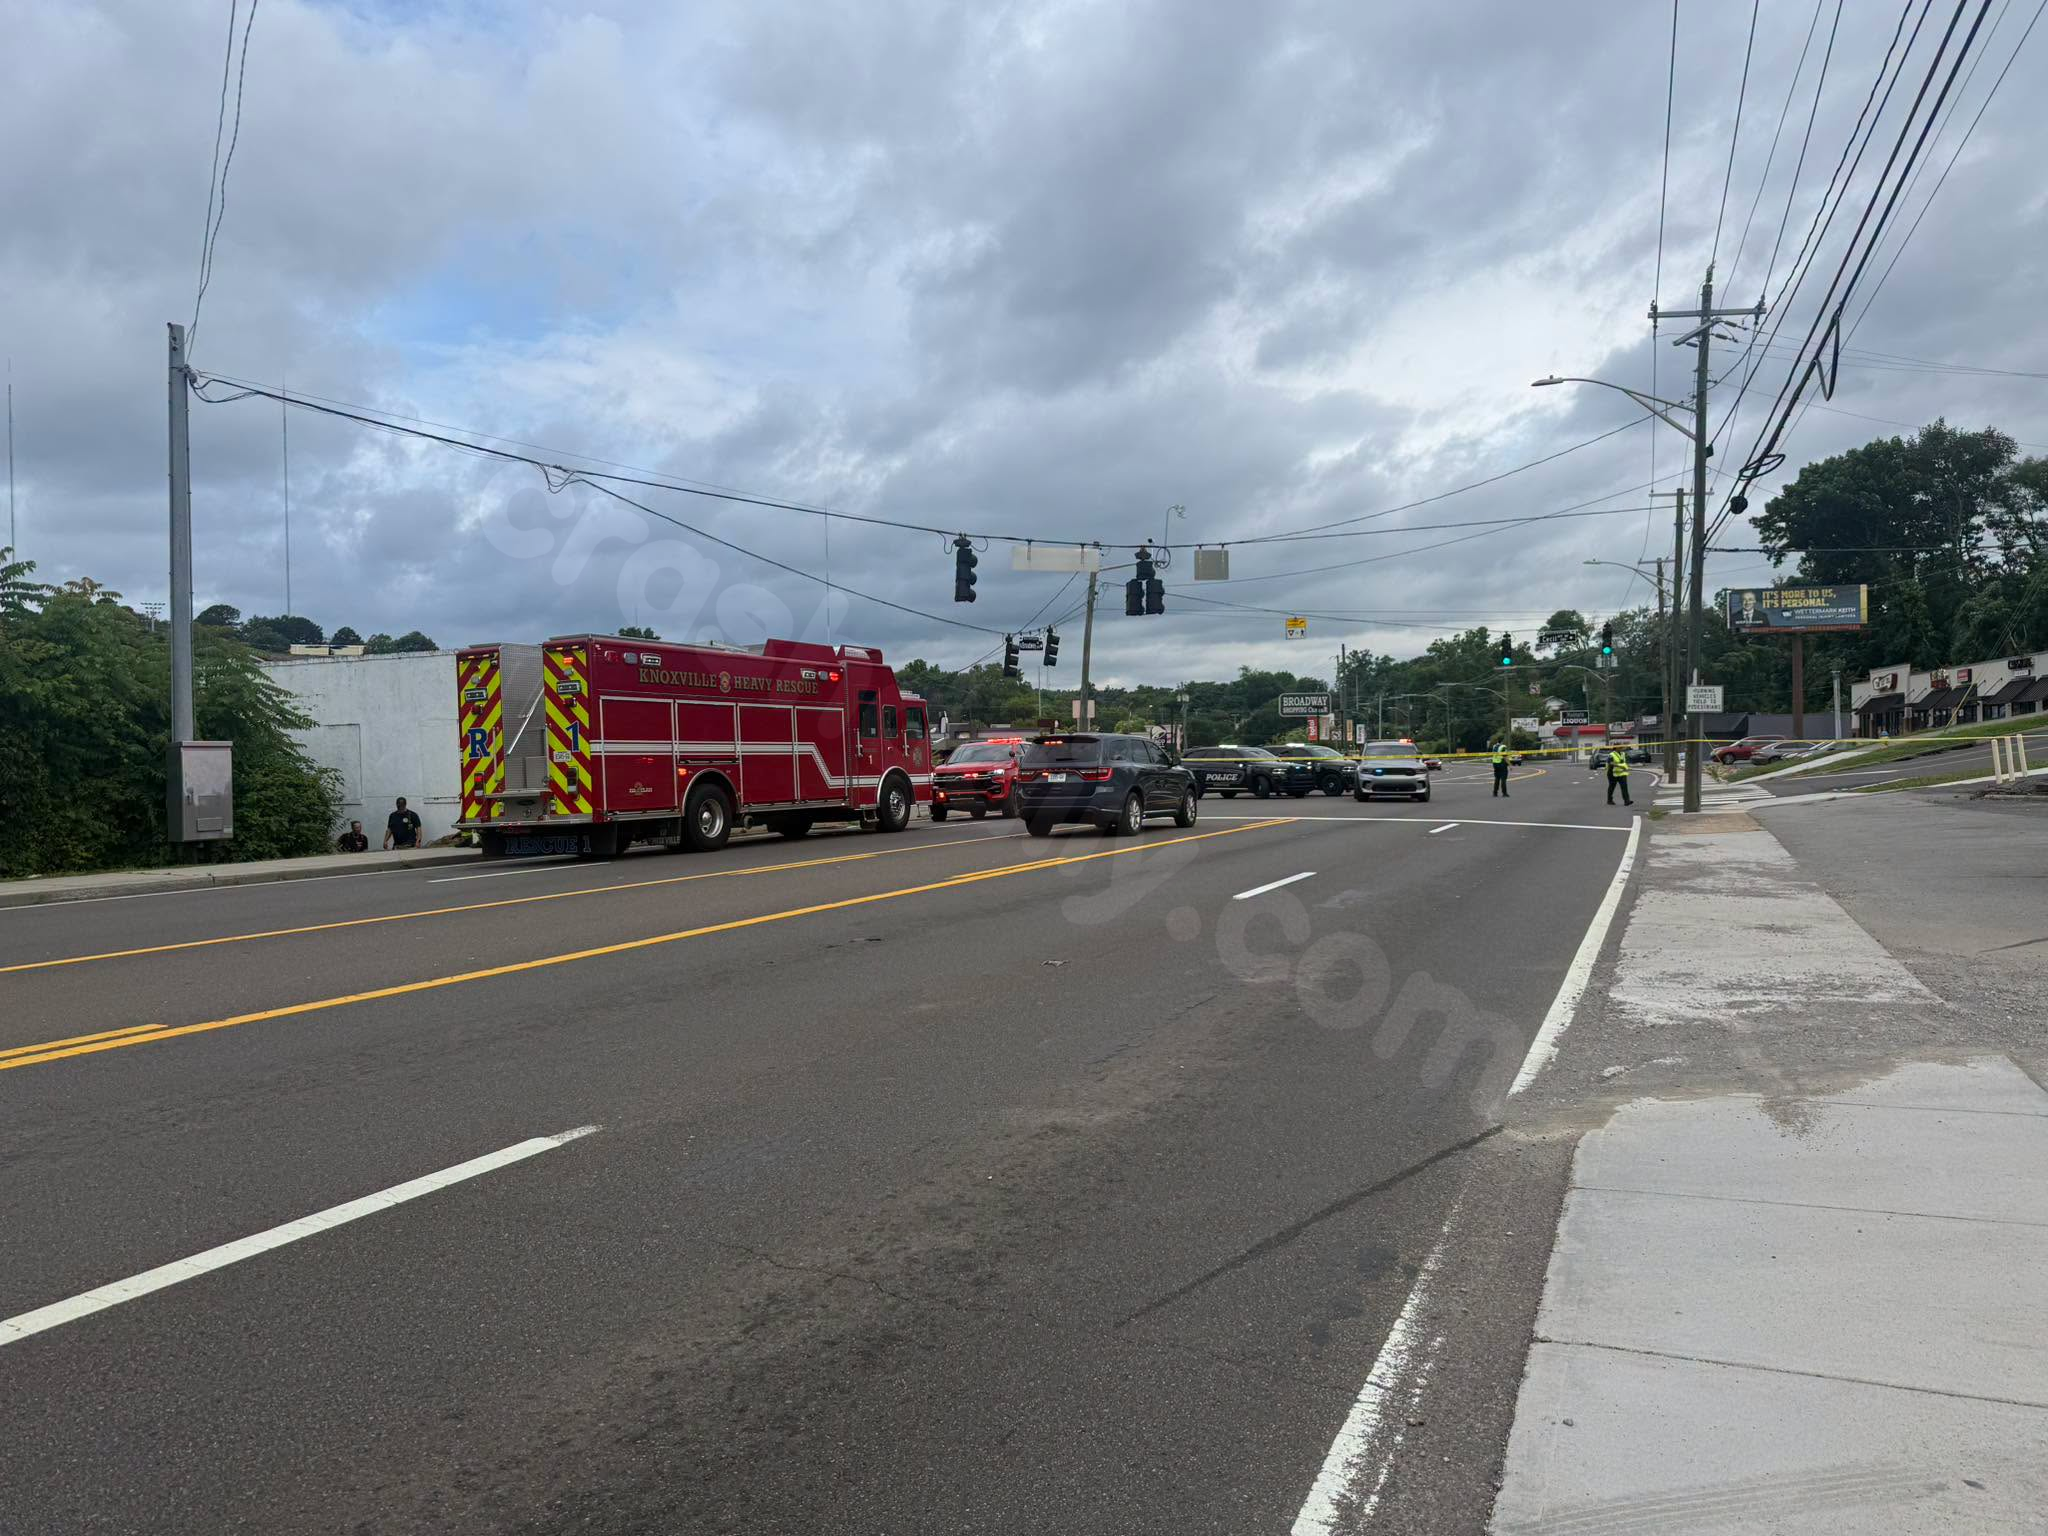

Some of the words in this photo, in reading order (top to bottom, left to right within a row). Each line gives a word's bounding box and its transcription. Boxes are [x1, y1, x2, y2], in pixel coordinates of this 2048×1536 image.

[1762, 591, 1779, 600] IT'S
[1781, 590, 1806, 599] MORE
[1808, 590, 1821, 599] TO
[1762, 600, 1779, 608] IT'S
[1781, 598, 1830, 608] PERSONAL.
[639, 667, 717, 688] KNOXVILLE
[734, 675, 772, 692] HEAVY
[776, 679, 819, 695] RESCUE
[1283, 696, 1328, 707] BROADWAY
[468, 727, 491, 759] R
[565, 720, 580, 753] 1
[1206, 773, 1239, 782] POLICE
[504, 836, 579, 854] RESCUE
[582, 835, 593, 854] 1
